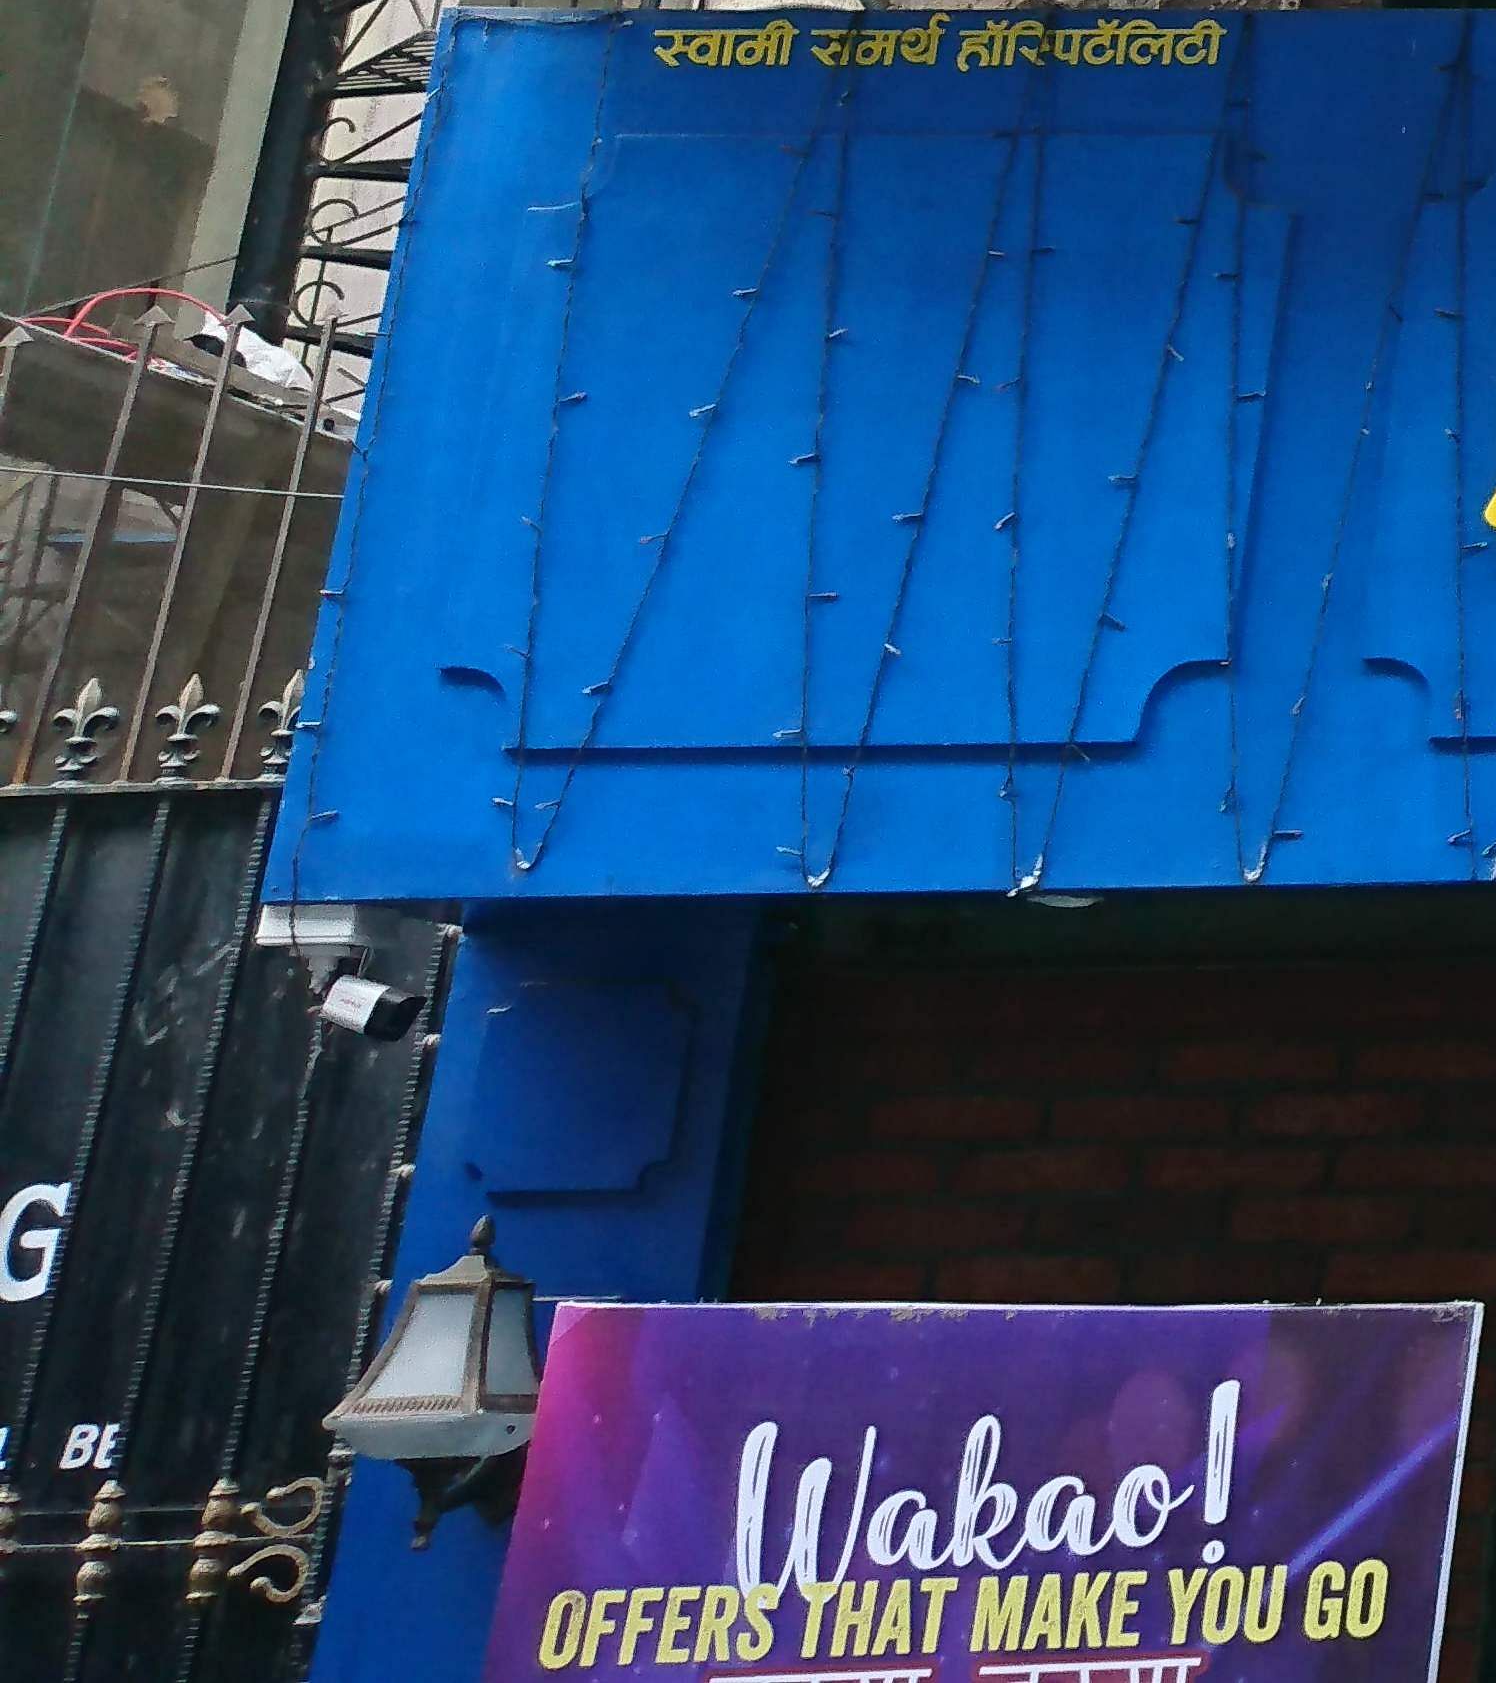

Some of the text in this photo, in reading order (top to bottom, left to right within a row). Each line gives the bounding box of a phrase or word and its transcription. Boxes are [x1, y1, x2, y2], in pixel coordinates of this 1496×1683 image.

[654, 19, 799, 67] स्वामी
[811, 13, 951, 67] समर्थ
[538, 1559, 1390, 1669] OFFERS THAT MAKE YOU GO
